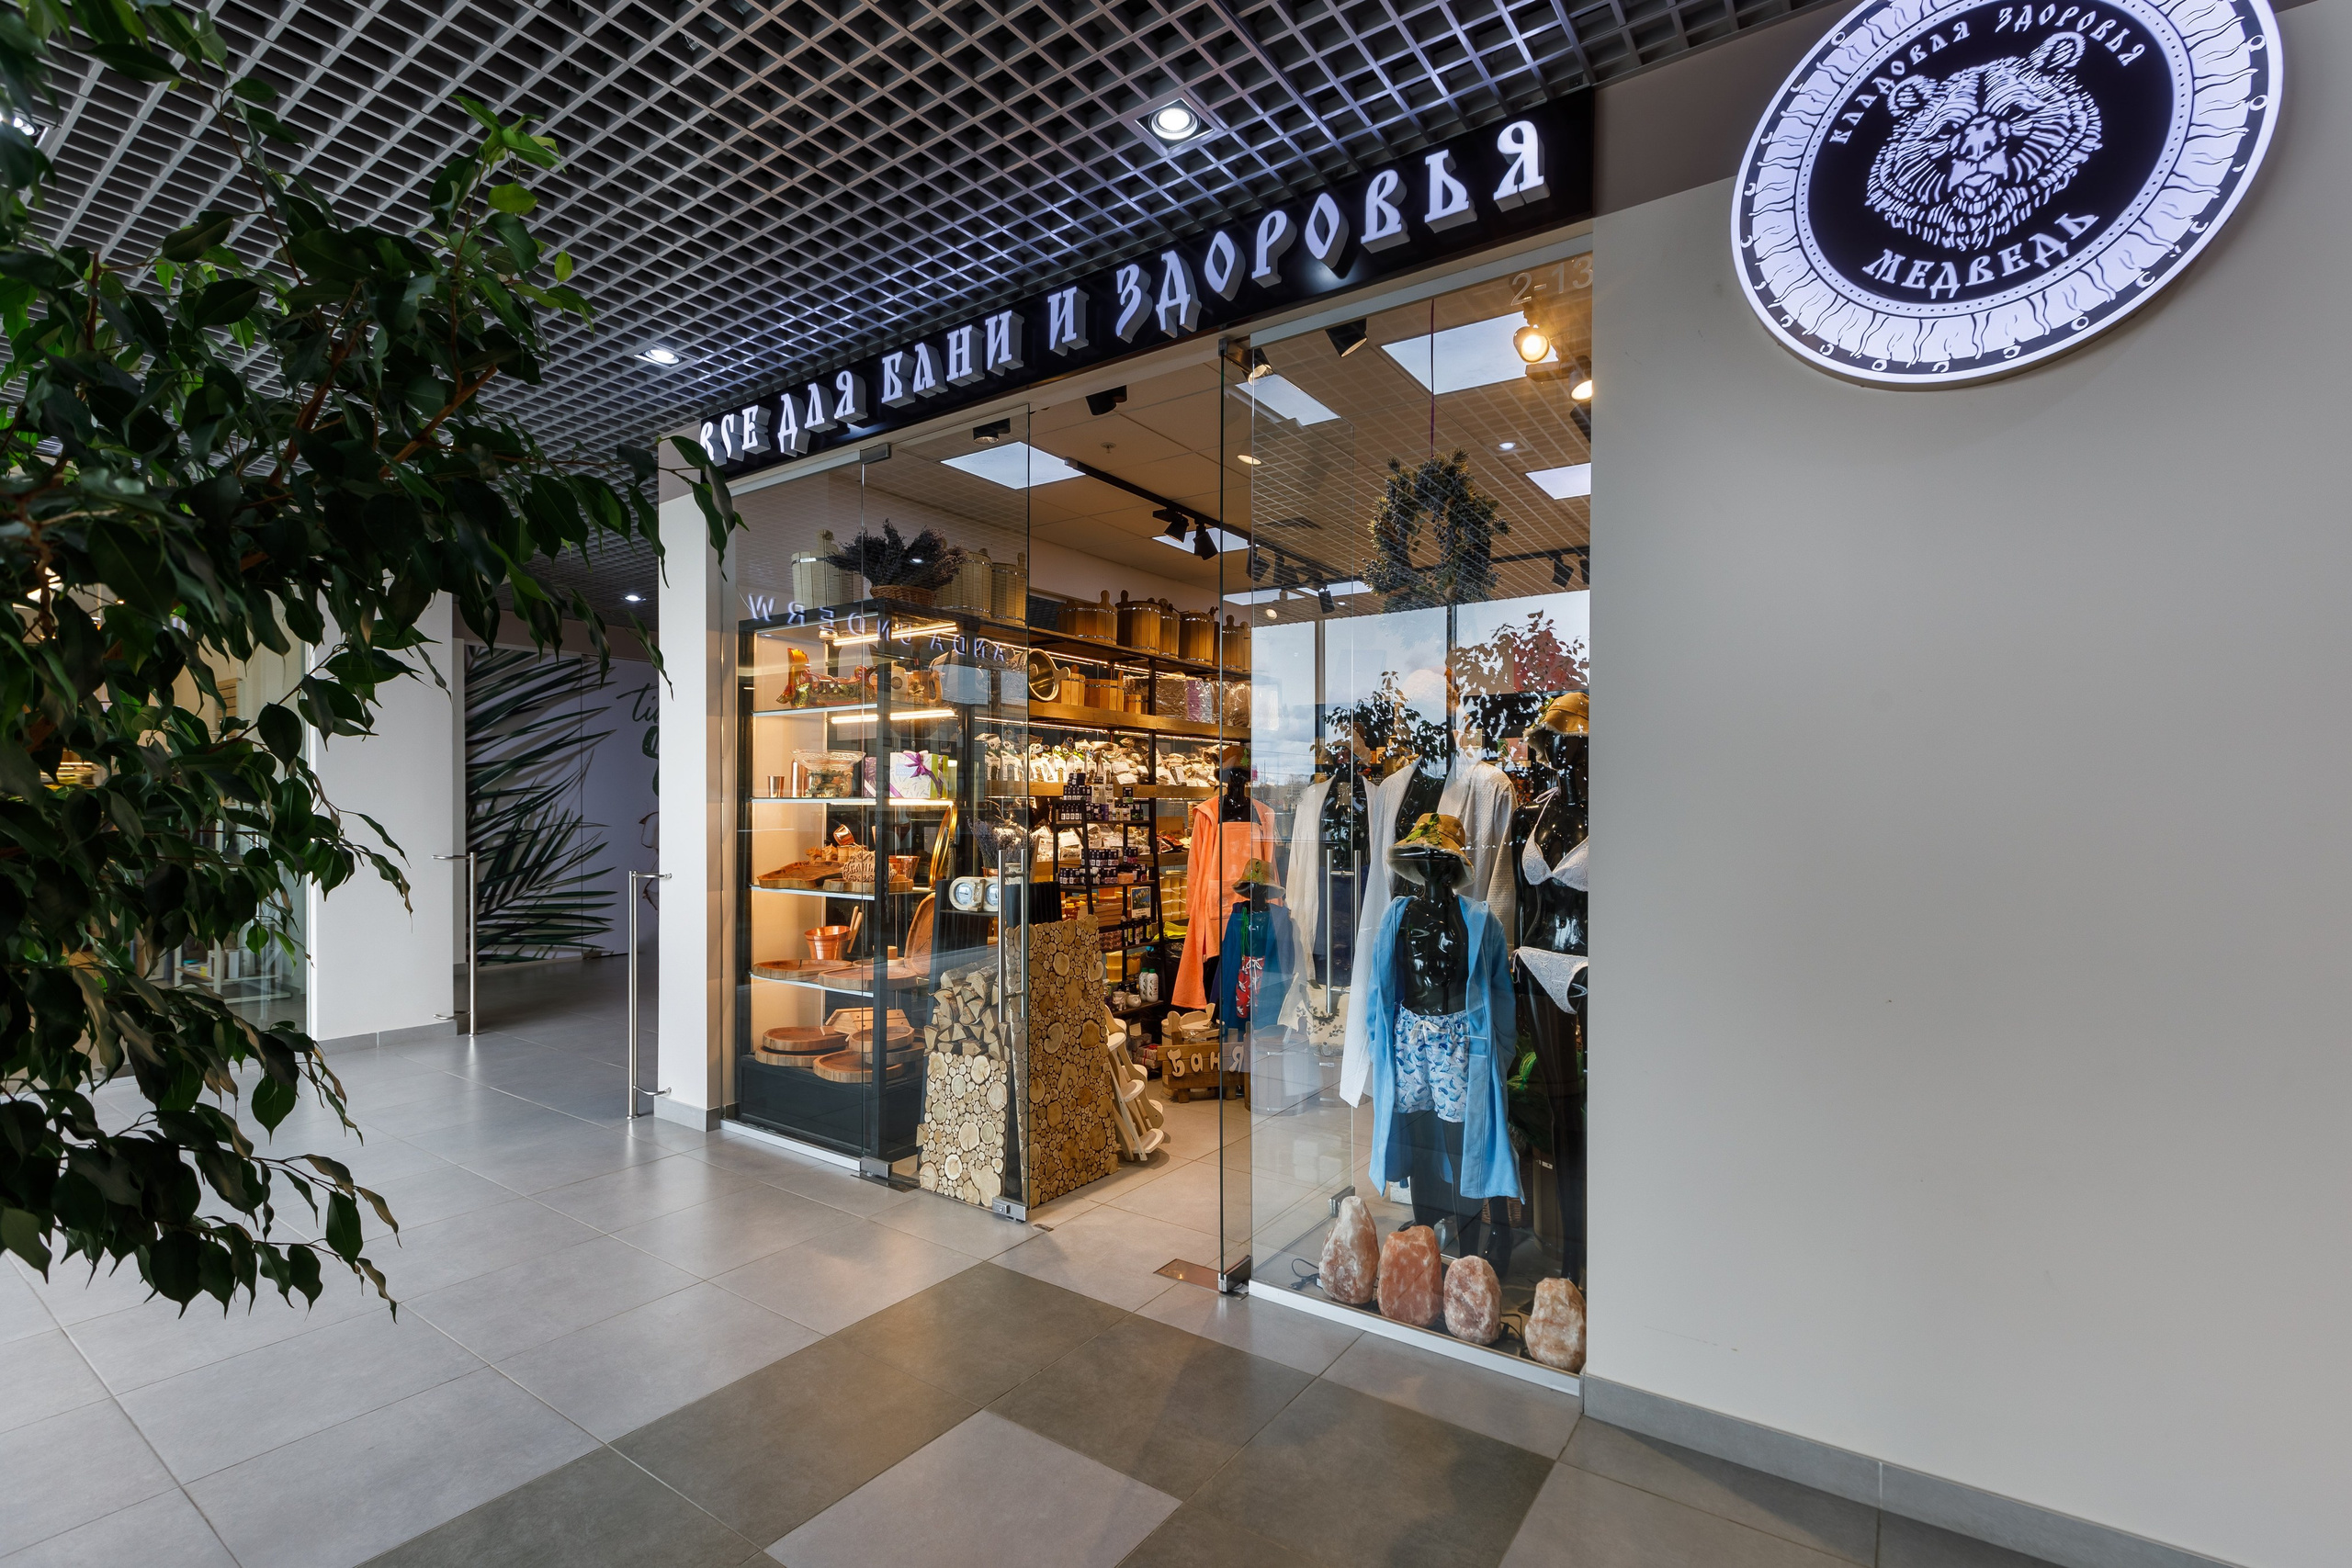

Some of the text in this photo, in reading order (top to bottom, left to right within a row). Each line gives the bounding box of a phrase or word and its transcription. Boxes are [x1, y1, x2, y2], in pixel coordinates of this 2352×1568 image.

[1829, 3, 2145, 145] КЛАДОВАЯ ЗДОРОВЬЯ
[700, 119, 1547, 461] ВСЕ ДЛЯ БАНИ И ЗДОРОВЬЯ
[1510, 256, 1593, 306] 2-13
[1861, 212, 2100, 300] МЕДВЕДЬ
